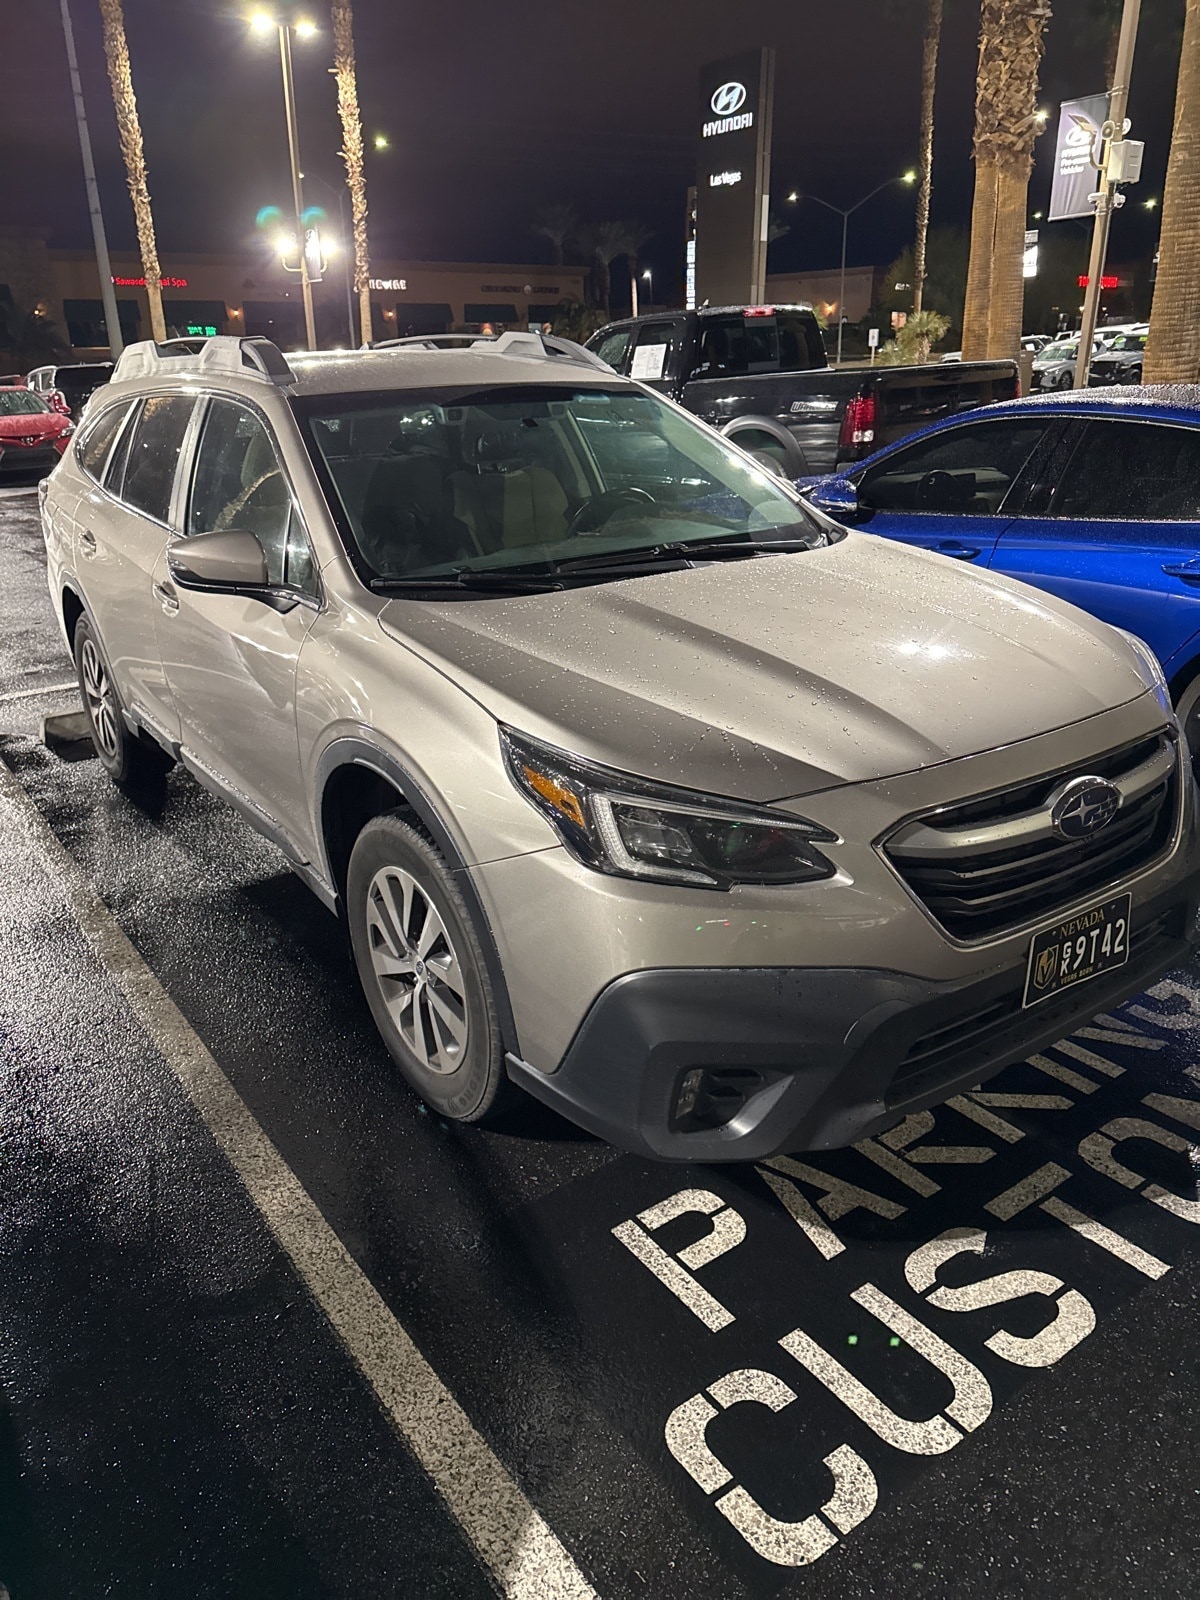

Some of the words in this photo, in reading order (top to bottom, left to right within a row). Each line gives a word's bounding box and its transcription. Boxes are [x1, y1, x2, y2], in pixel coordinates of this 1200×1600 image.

[703, 112, 753, 138] HYUNDAI
[710, 174, 723, 187] Las
[721, 171, 742, 186] Vegas
[115, 276, 148, 286] Sawasde
[171, 277, 187, 288] Spa
[1059, 908, 1105, 940] NEVADA
[1060, 973, 1078, 985] VEGAS
